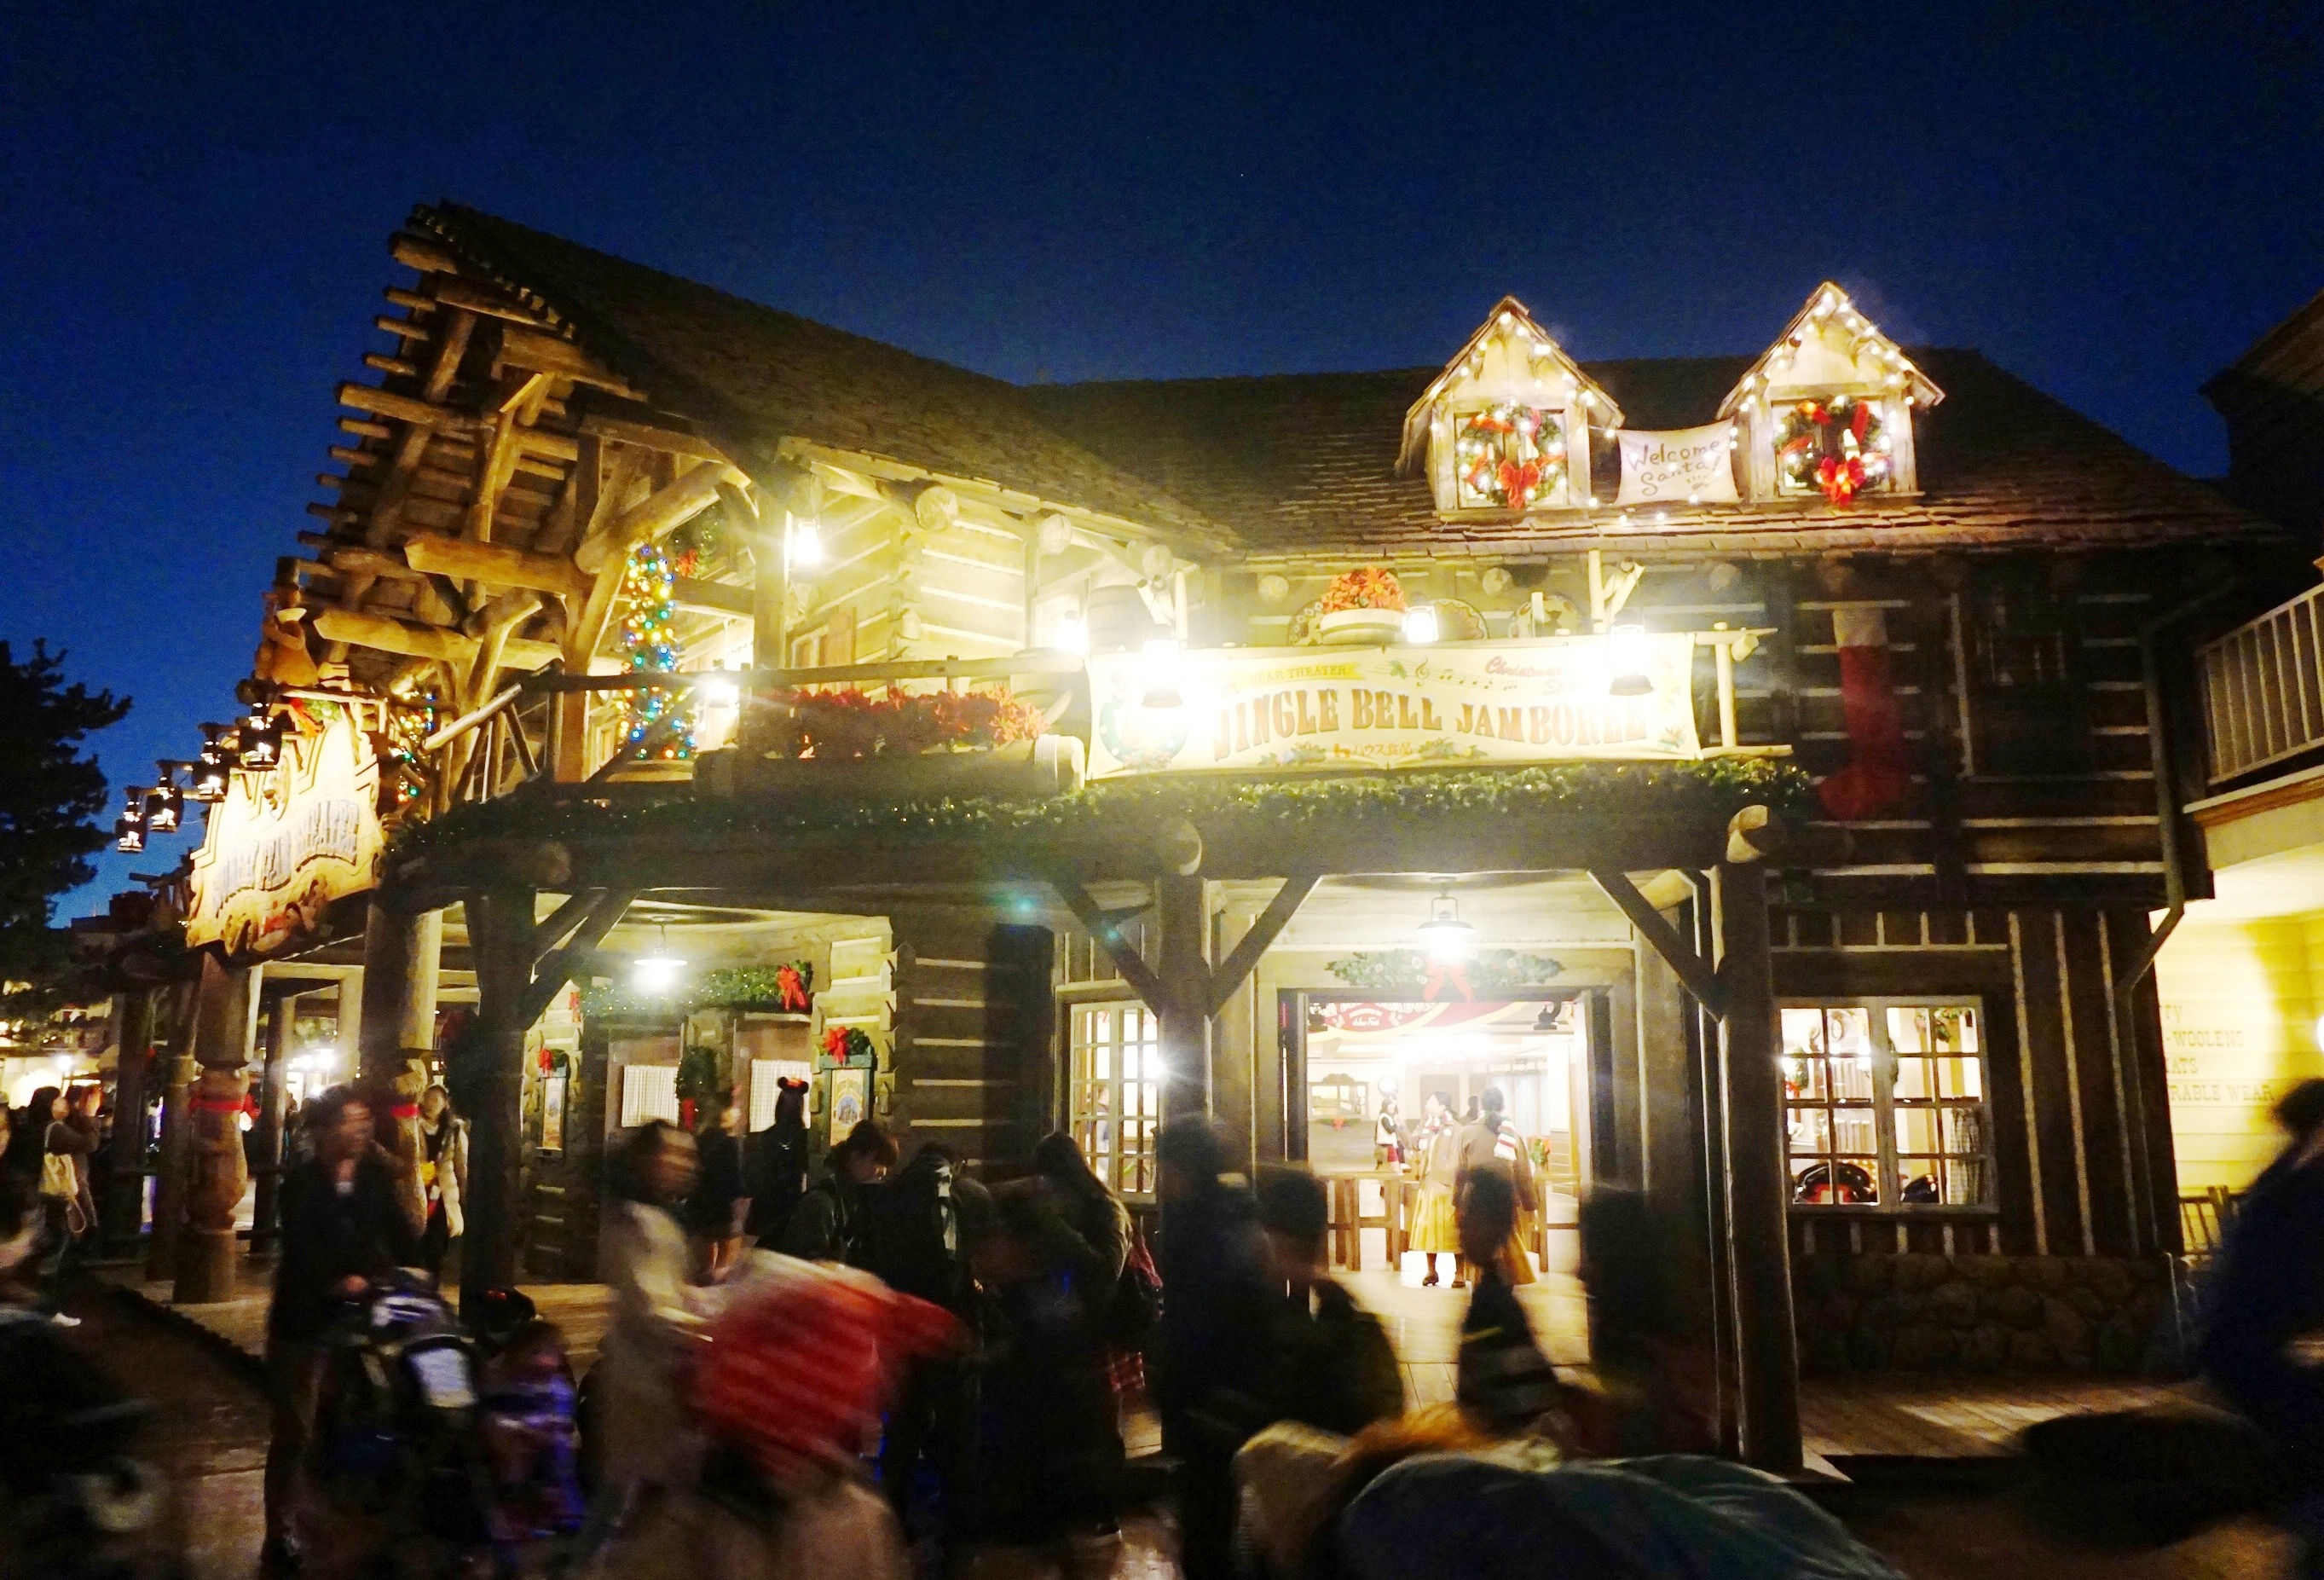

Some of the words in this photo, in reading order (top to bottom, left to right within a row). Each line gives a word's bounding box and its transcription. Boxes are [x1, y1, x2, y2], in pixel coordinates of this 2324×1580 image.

[1627, 440, 1721, 472] Welcome
[1287, 665, 1347, 679] THEATER
[1485, 655, 1563, 677] Christmas
[1212, 688, 1340, 762] JINGLE
[1351, 687, 1442, 730] BELL
[1455, 703, 1647, 746] JAMBOREE
[1352, 741, 1413, 757] ハウス食品
[2226, 1084, 2275, 1102] WEAR
